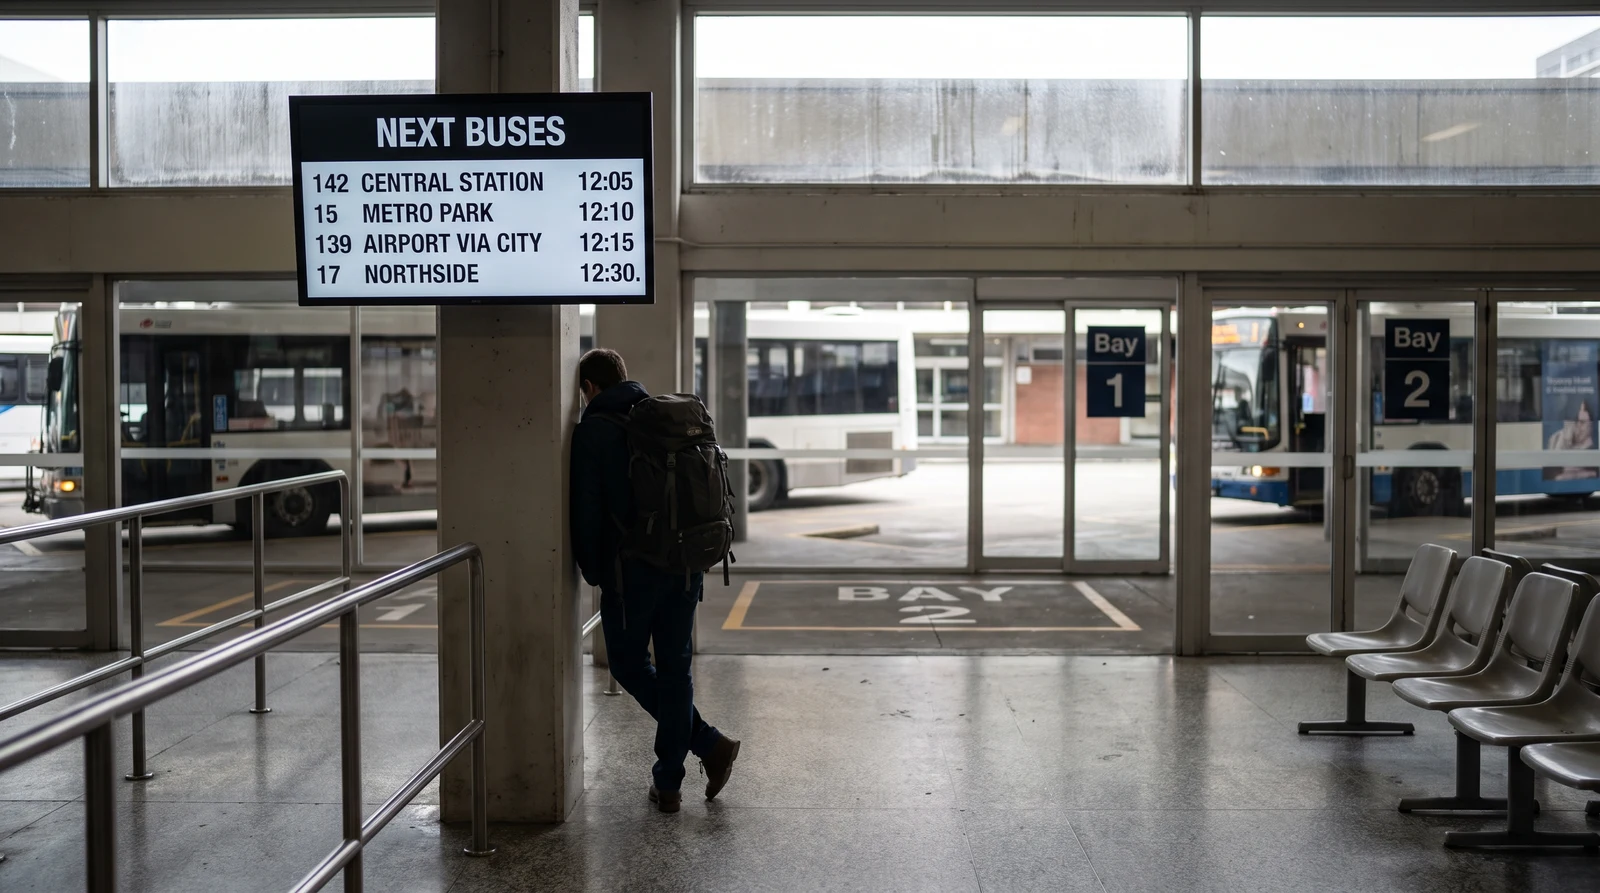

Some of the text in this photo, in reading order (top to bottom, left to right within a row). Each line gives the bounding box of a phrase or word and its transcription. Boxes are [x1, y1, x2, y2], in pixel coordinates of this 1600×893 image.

[376, 116, 565, 148] NEXT BUSES
[312, 171, 633, 193] 142 CENTRAL STATION 12:05
[314, 201, 634, 224] 15 METRO PARK 12:10
[315, 232, 634, 254] 139 AIRPORT VIA CITY 12:15
[316, 262, 641, 285] 17 NORTHSIDE 12:30.
[1094, 334, 1139, 358] Bay
[1395, 327, 1441, 353] Bay
[1107, 373, 1123, 408] 1
[1403, 371, 1430, 408] 2
[837, 586, 1014, 602] BAY
[899, 605, 977, 624] 2
